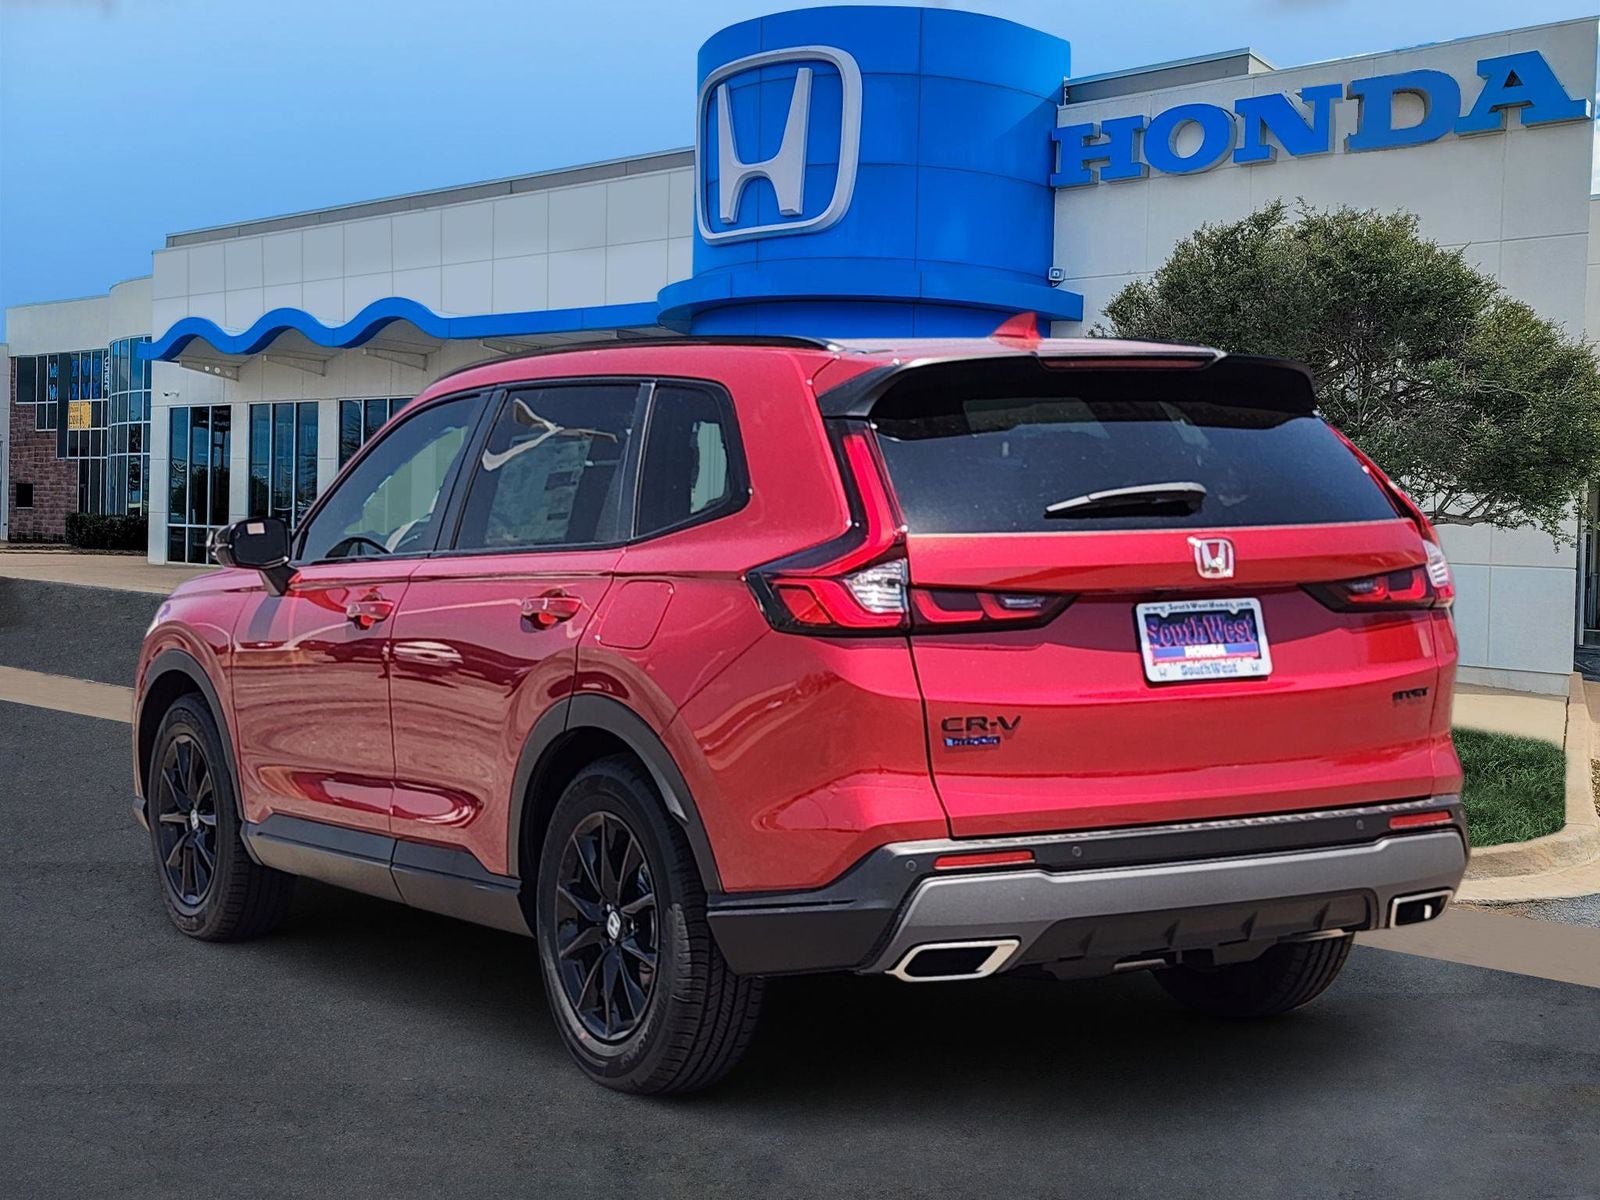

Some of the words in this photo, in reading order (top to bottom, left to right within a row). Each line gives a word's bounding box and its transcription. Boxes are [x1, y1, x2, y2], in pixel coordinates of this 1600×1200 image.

[1050, 50, 1592, 188] HONDA
[1147, 614, 1256, 648] SouthWest
[941, 715, 1022, 732] CR-V
